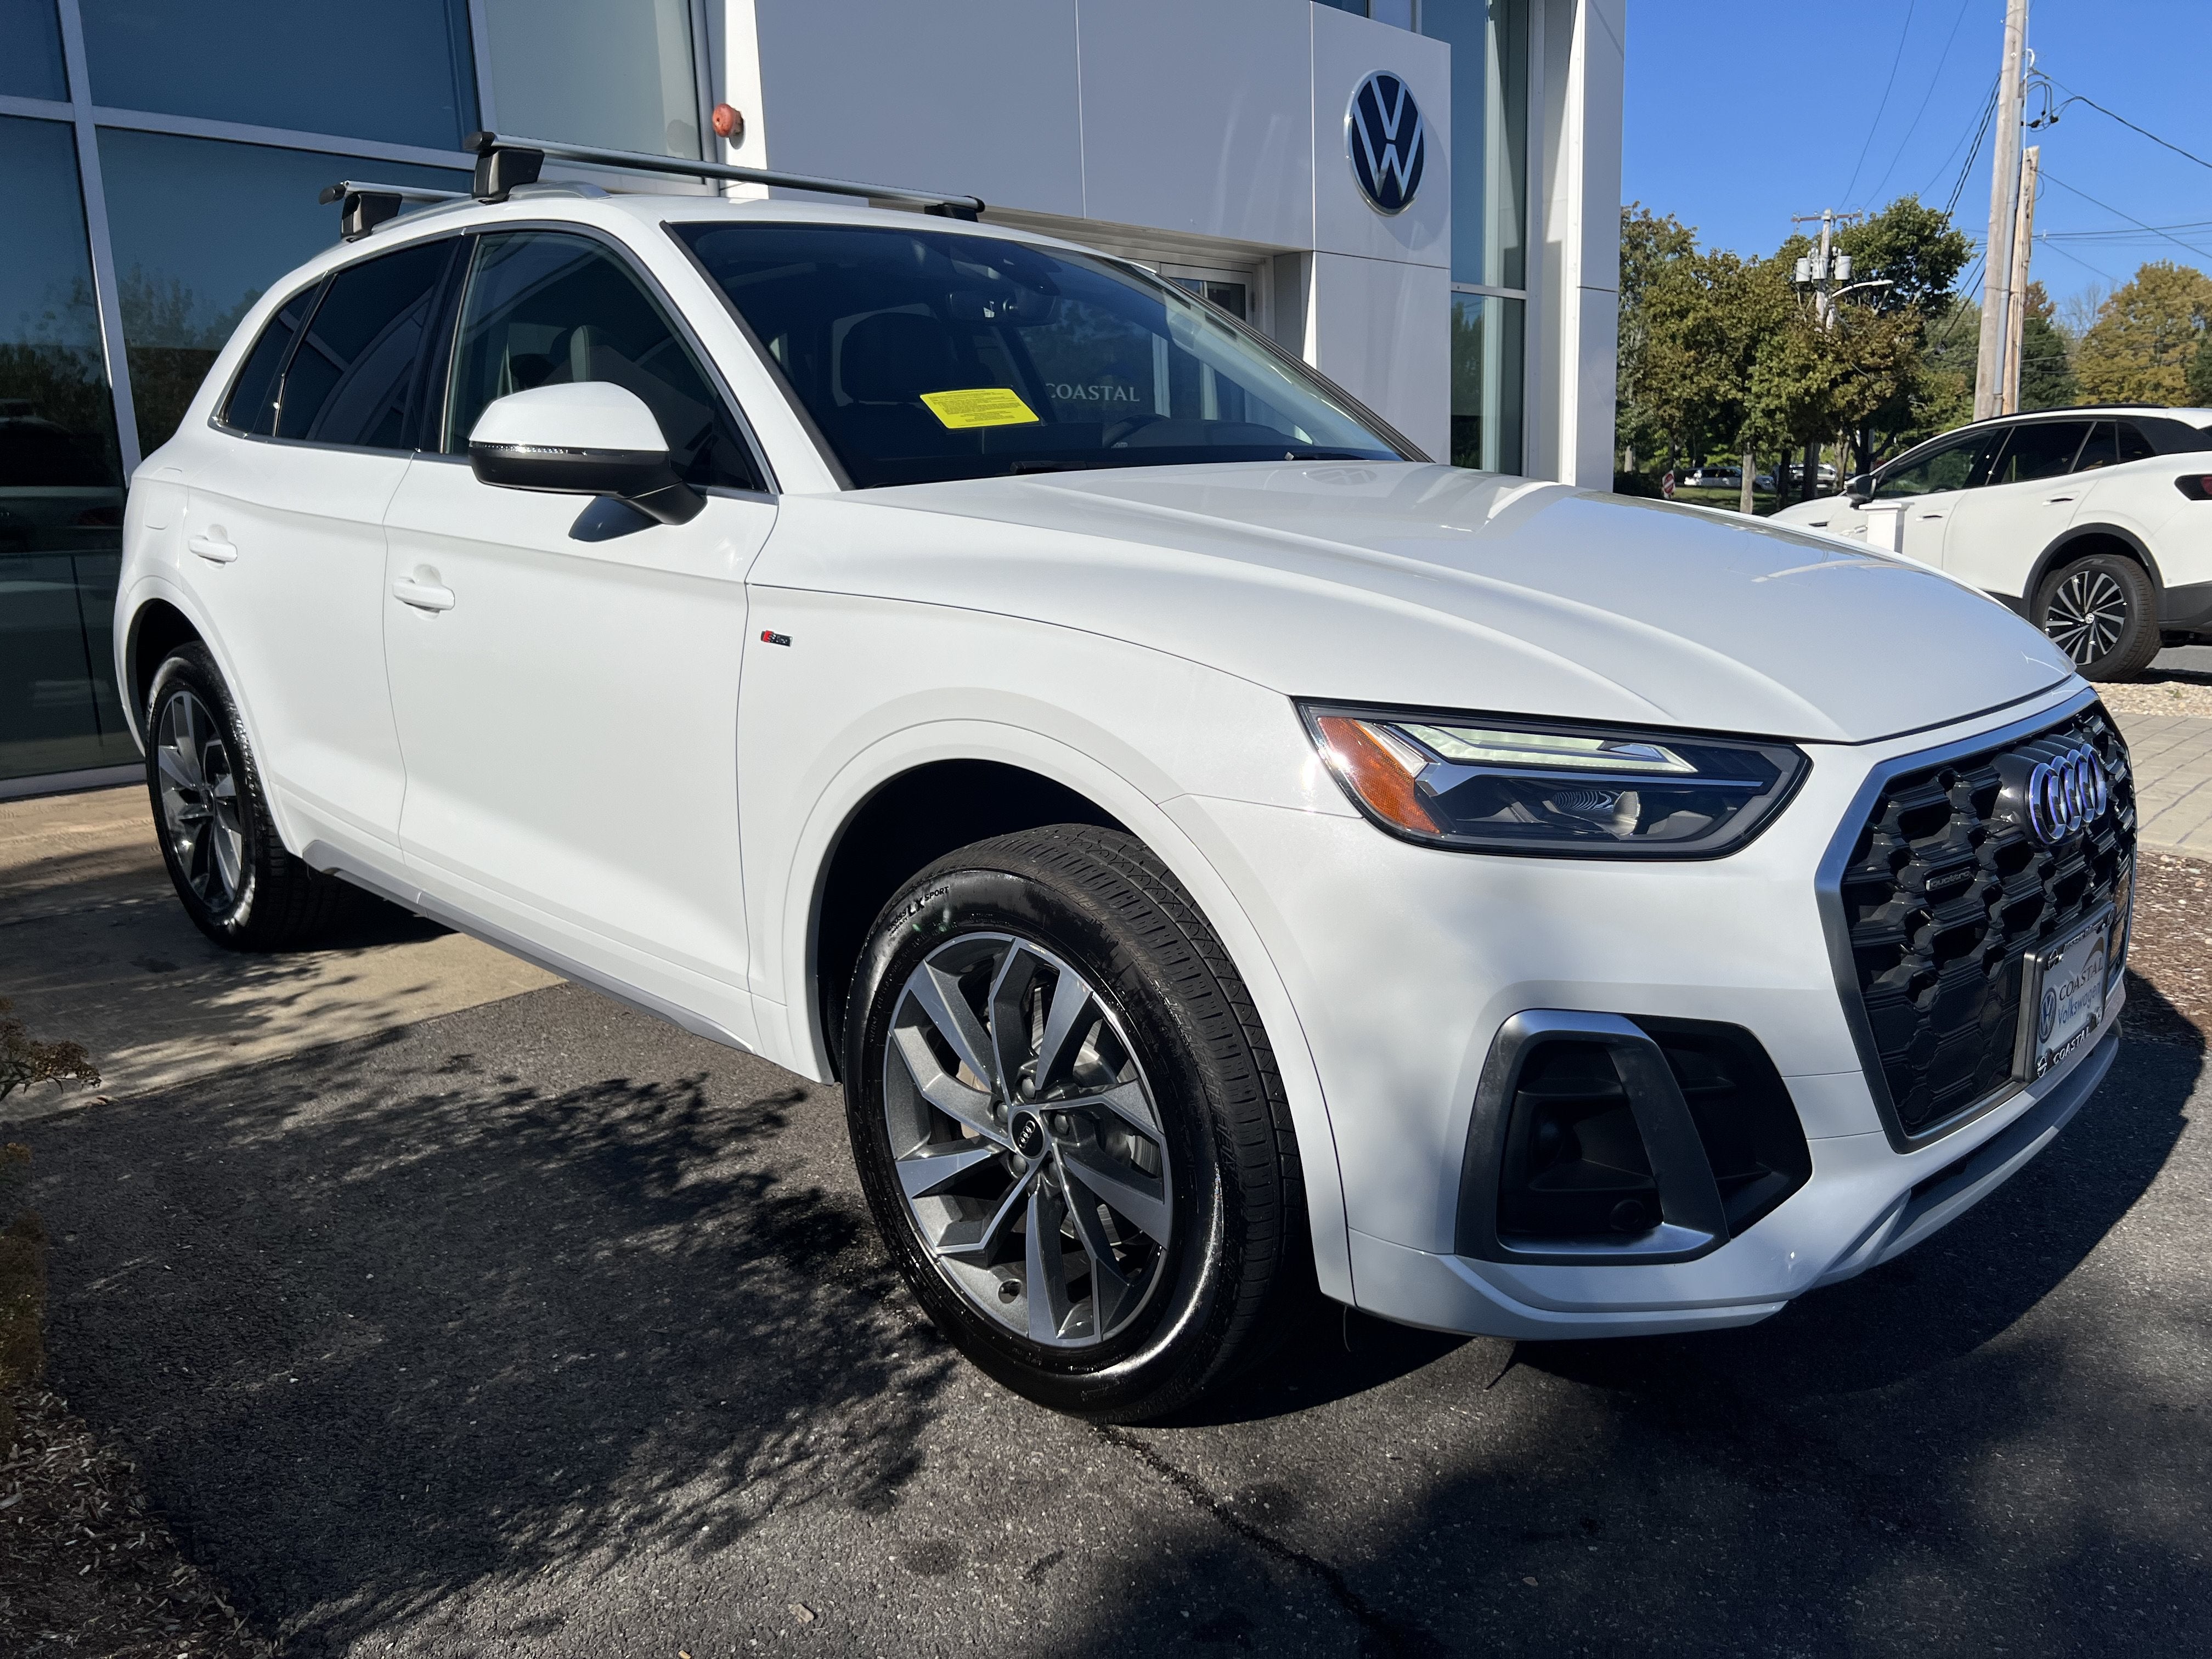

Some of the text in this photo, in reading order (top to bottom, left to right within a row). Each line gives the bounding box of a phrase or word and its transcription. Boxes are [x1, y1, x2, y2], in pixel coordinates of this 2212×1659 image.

[907, 896, 926, 917] LX
[924, 886, 949, 901] SPORT
[2059, 957, 2103, 1001] COASTAL
[2058, 982, 2101, 1027] Volkswagen
[2053, 1026, 2090, 1065] COASTAL
